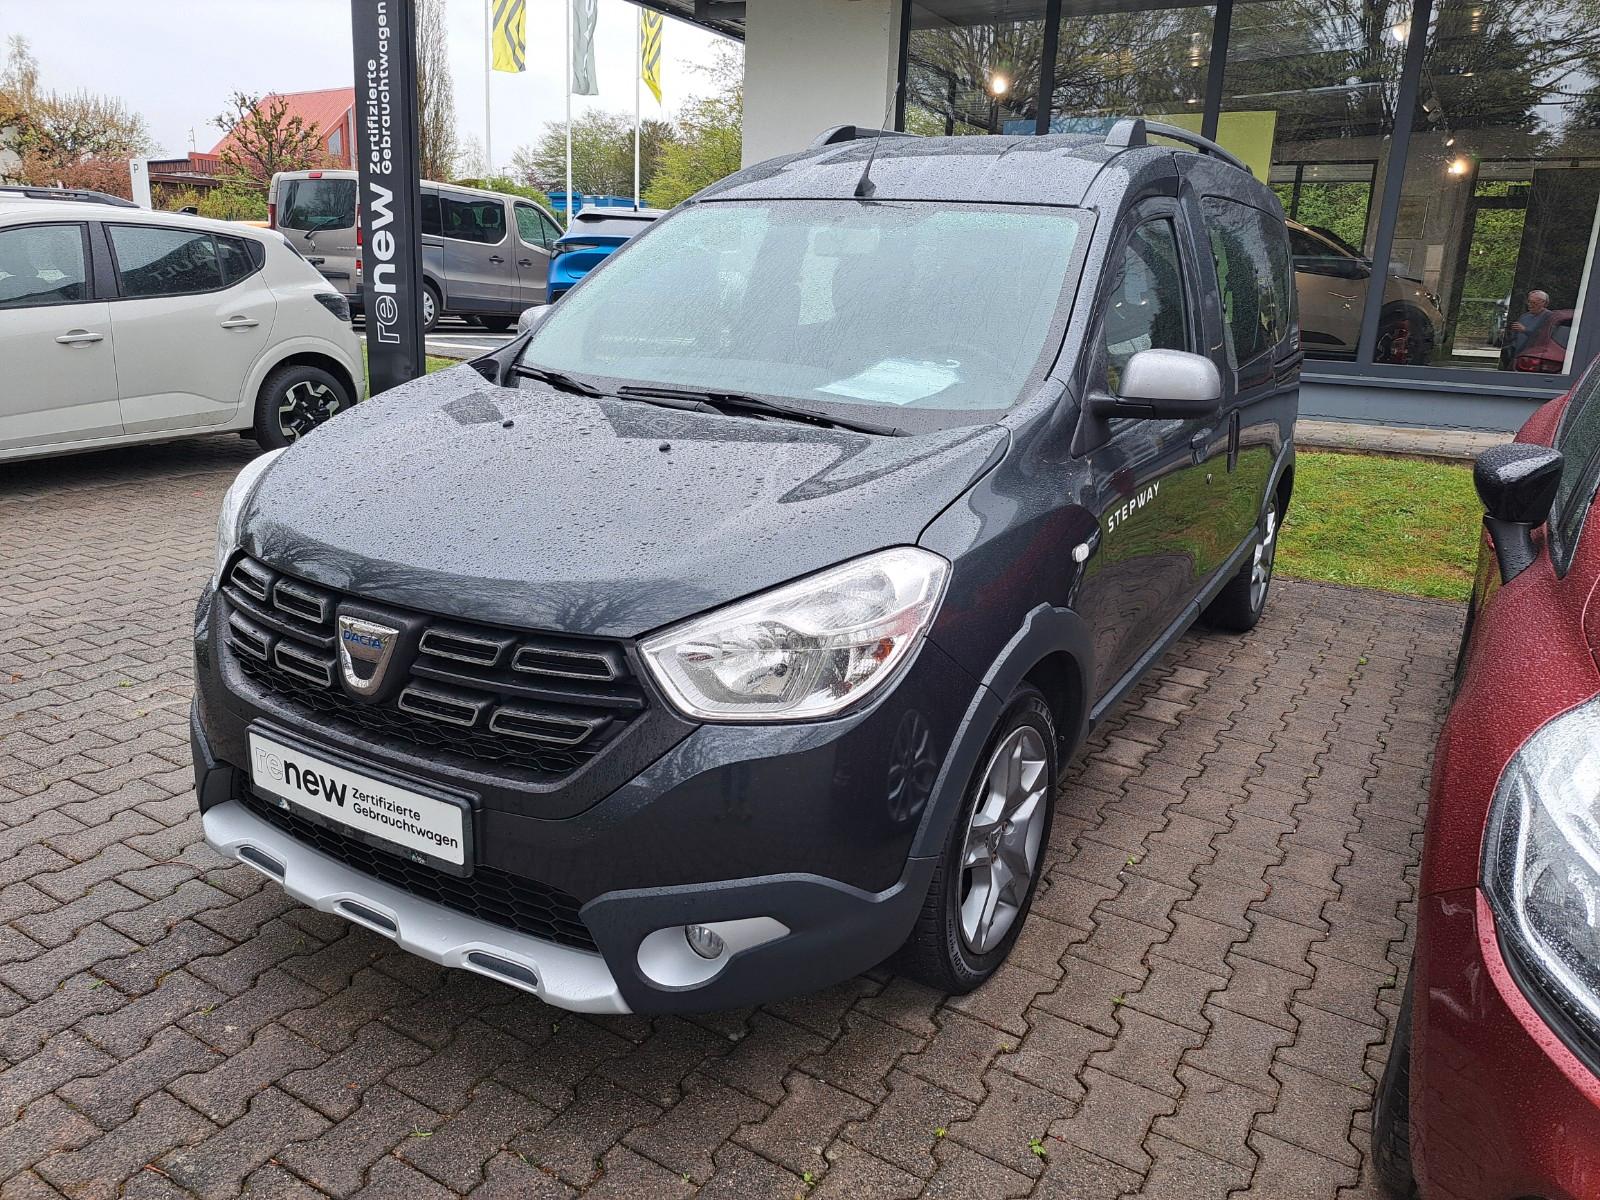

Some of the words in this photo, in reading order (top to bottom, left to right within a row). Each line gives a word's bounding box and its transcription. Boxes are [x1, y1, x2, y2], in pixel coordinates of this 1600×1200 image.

[378, 2, 391, 174] Gebrauchtwagen
[367, 59, 380, 174] Zertifizierte
[370, 182, 400, 343] renew
[1108, 481, 1160, 533] STEPWAY
[344, 630, 382, 649] DACIA
[255, 747, 347, 807] renew
[352, 788, 421, 821] Zertifizierte
[353, 803, 458, 848] Gebrauchtwagen
